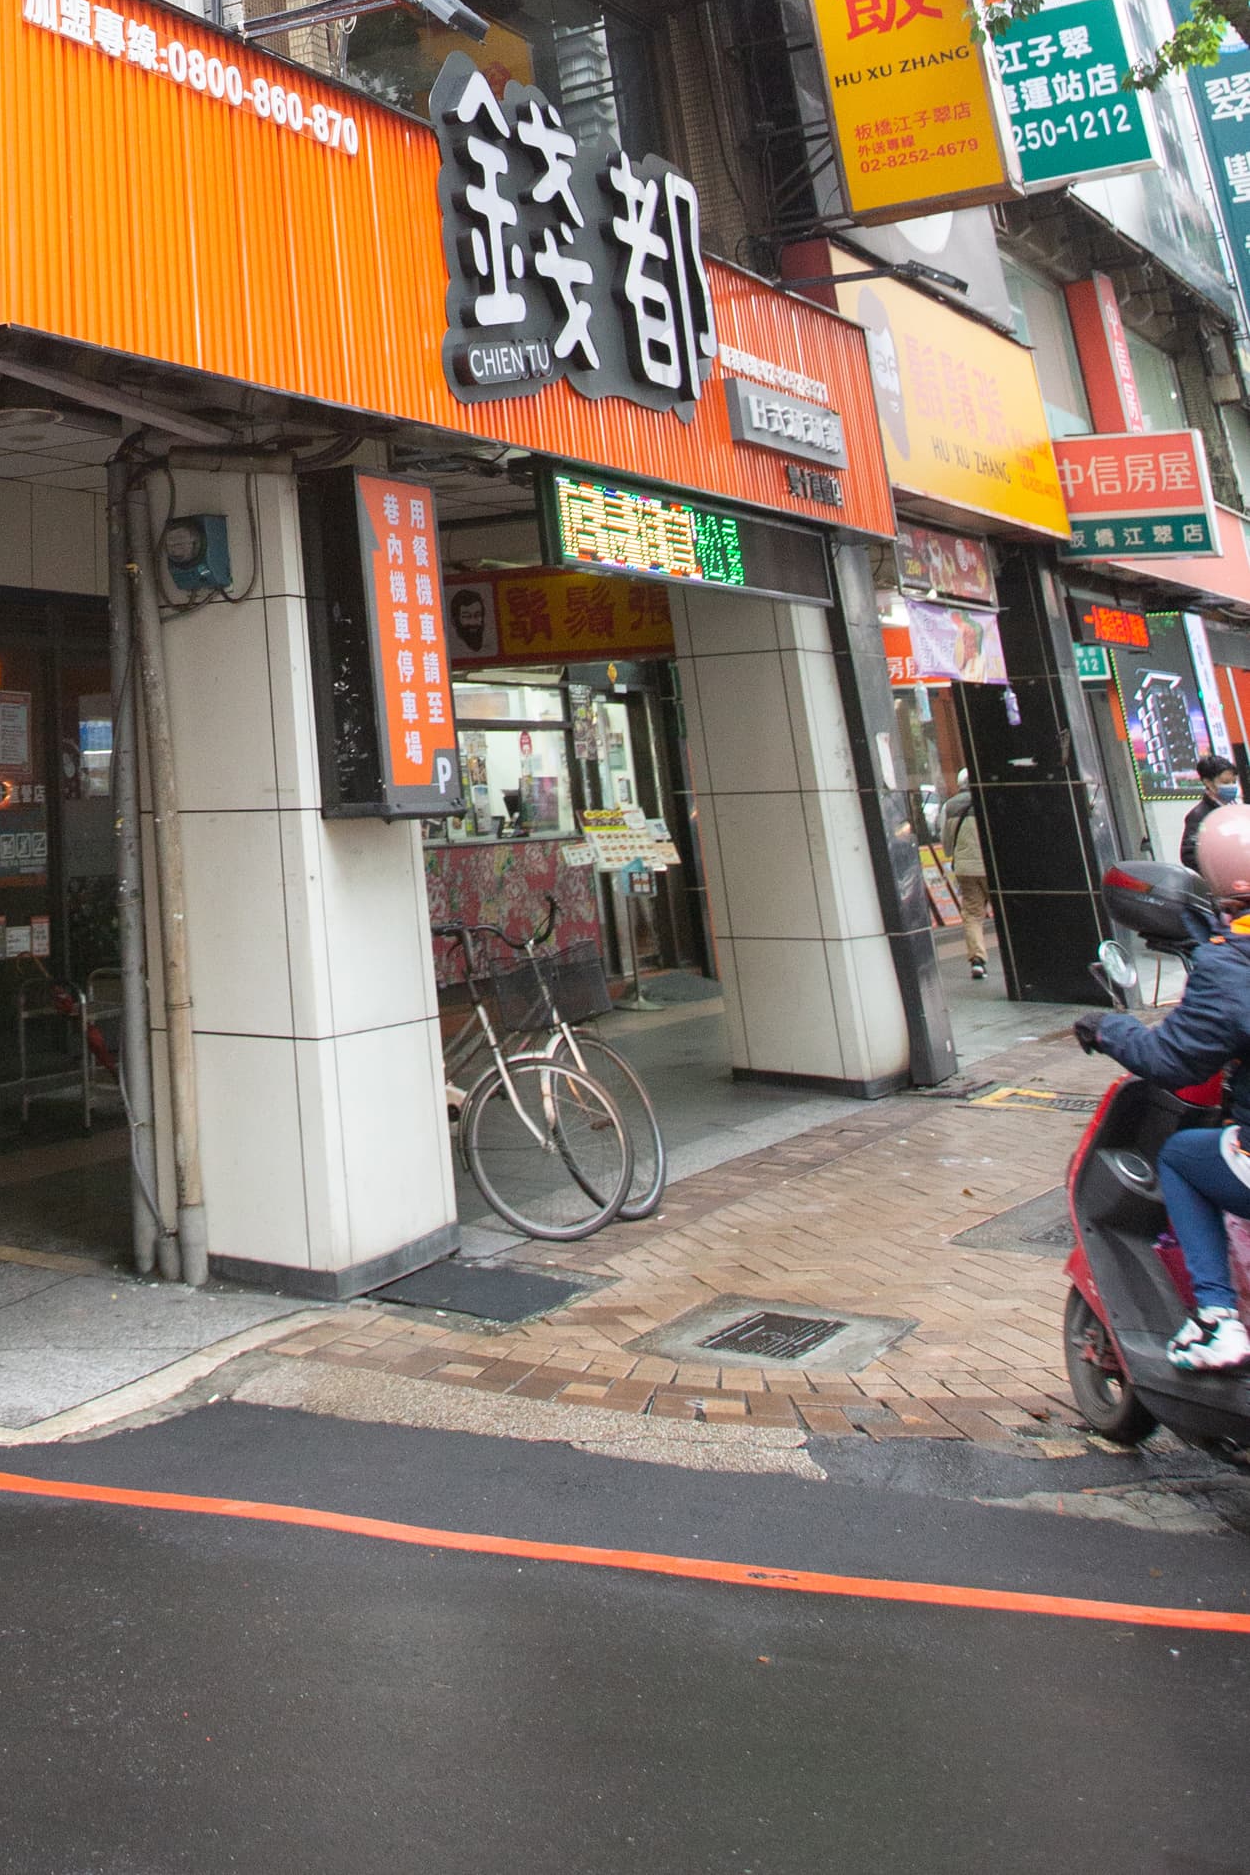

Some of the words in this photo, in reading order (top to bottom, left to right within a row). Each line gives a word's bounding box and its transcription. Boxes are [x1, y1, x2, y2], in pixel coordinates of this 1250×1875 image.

[834, 70, 862, 89] HU
[867, 62, 893, 81] XU
[899, 44, 970, 74] ZHANG
[995, 25, 1093, 75] 江子翠
[854, 101, 972, 142] 板橋江子翠店
[857, 134, 916, 159] 外送專線
[859, 137, 979, 174] 02-8252-4679
[456, 71, 718, 402] 錢都
[469, 346, 525, 377] CHIEN
[528, 343, 550, 373] TU
[931, 435, 950, 463] HU
[953, 443, 971, 470] XU
[974, 451, 1012, 484] ZHANG
[1059, 451, 1197, 498] 中信房屋
[383, 493, 424, 765] 巷內機車停車場
[408, 498, 446, 725] 用餐機車請至
[436, 756, 453, 794] P
